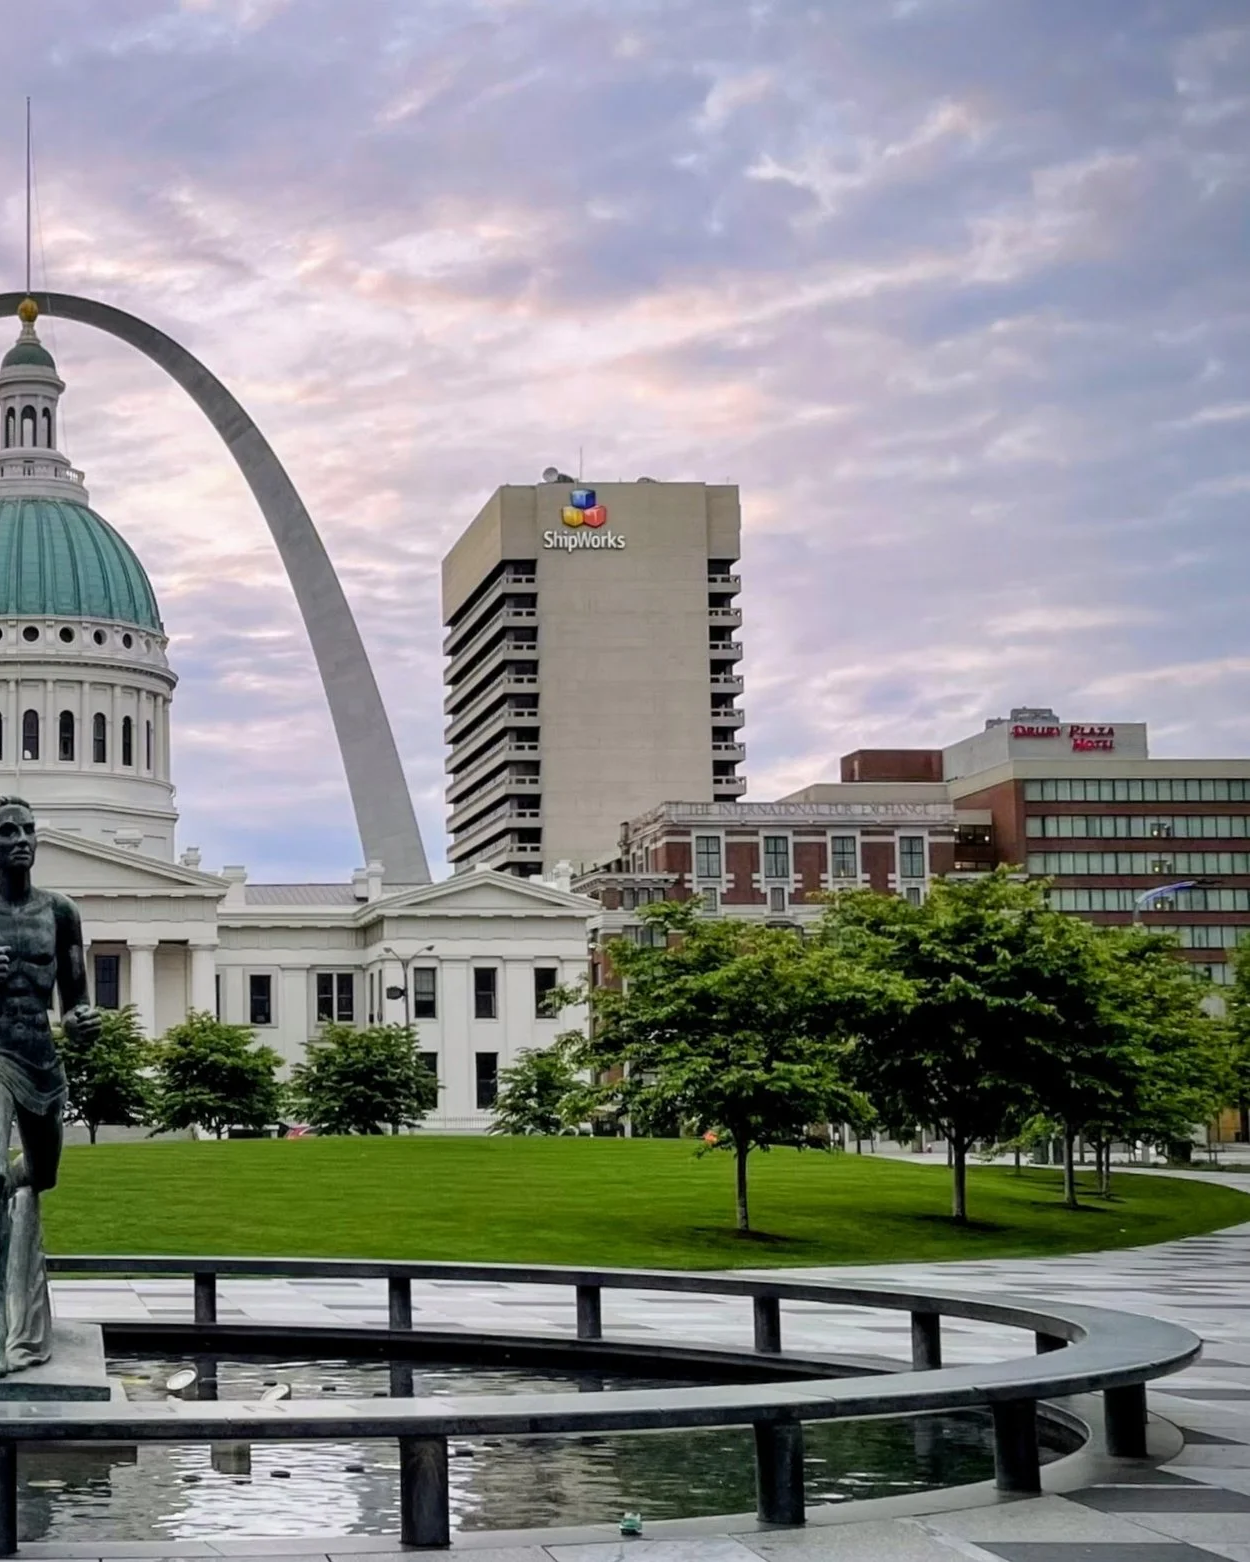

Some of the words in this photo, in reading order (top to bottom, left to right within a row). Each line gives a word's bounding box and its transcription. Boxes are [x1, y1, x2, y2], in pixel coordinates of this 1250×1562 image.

[543, 530, 626, 553] ShipWorks
[1069, 725, 1114, 738] PLAZA
[689, 803, 713, 816] THE
